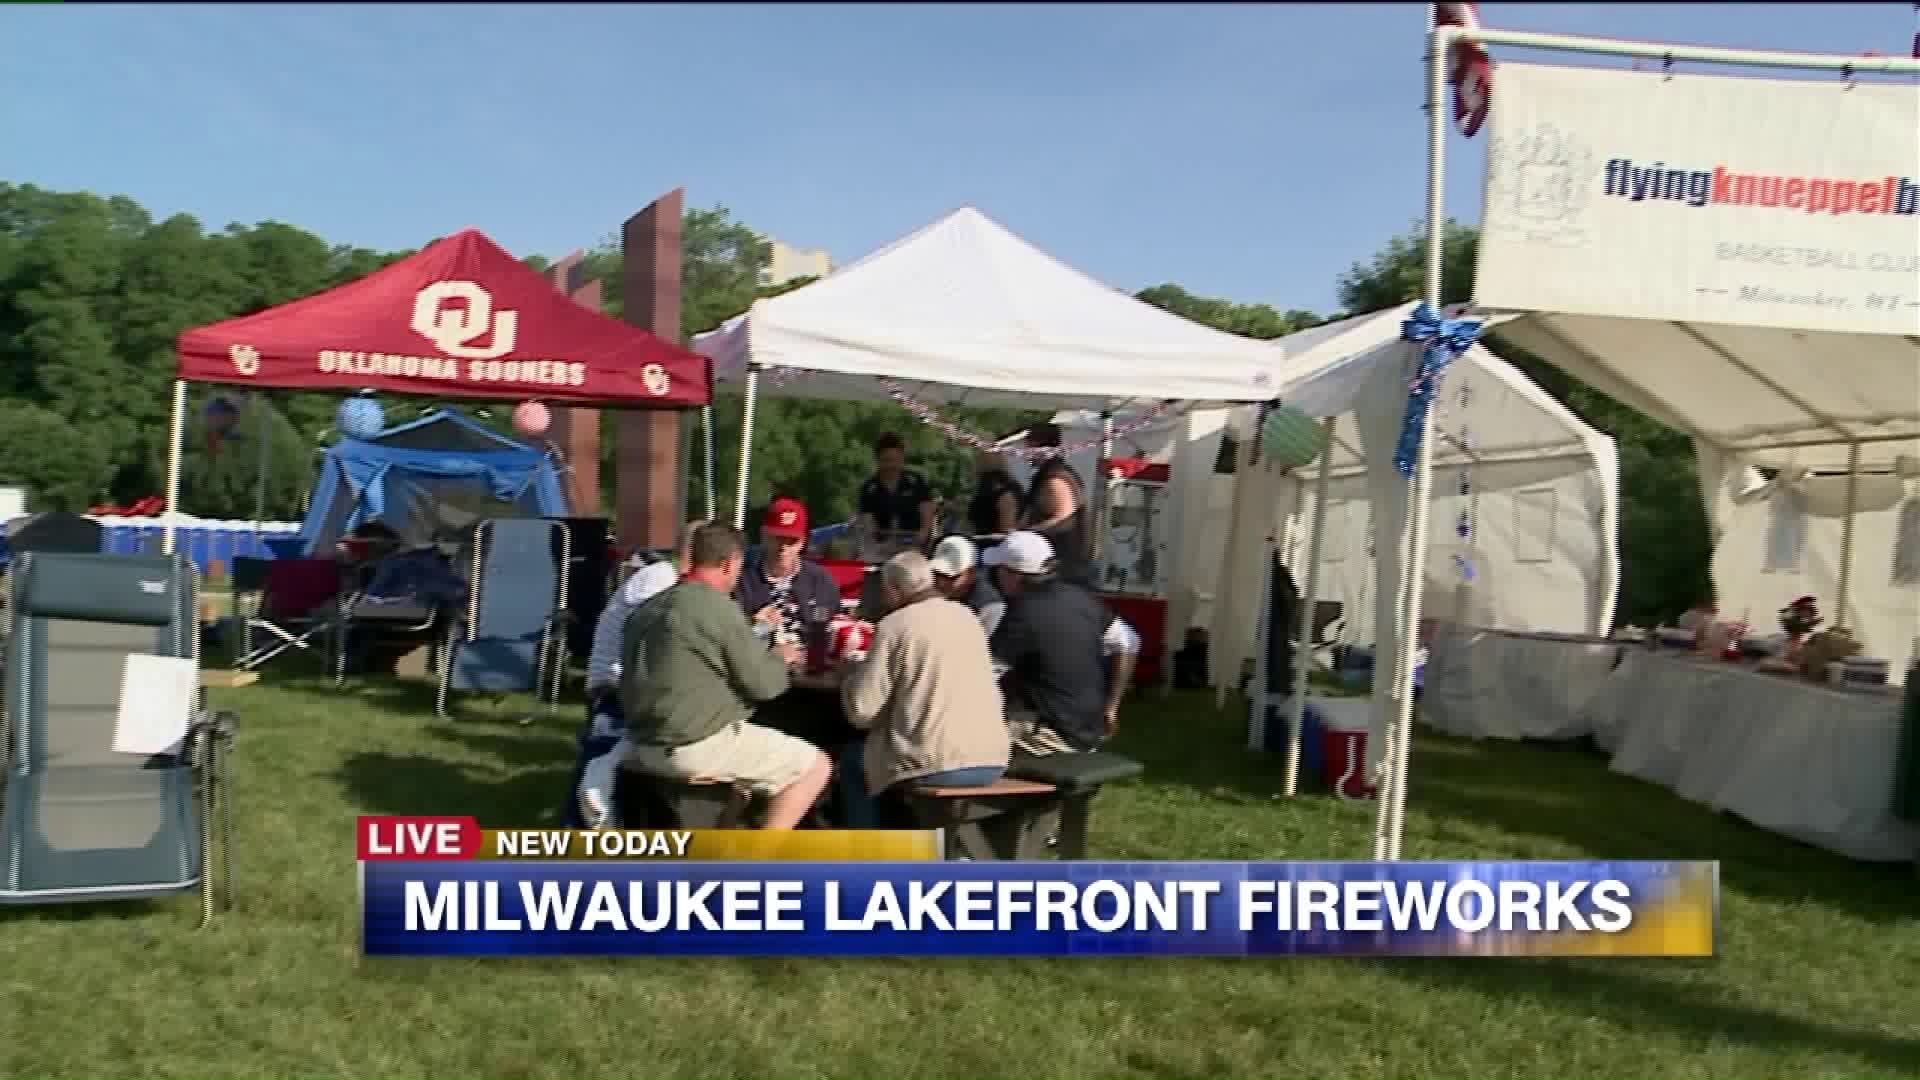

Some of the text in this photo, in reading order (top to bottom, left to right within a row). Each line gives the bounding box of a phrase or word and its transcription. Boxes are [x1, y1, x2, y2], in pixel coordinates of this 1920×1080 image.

[1715, 242, 1857, 271] BASKETBALL
[410, 280, 519, 358] OU
[318, 350, 587, 386] OKLAHOMA SOONERS
